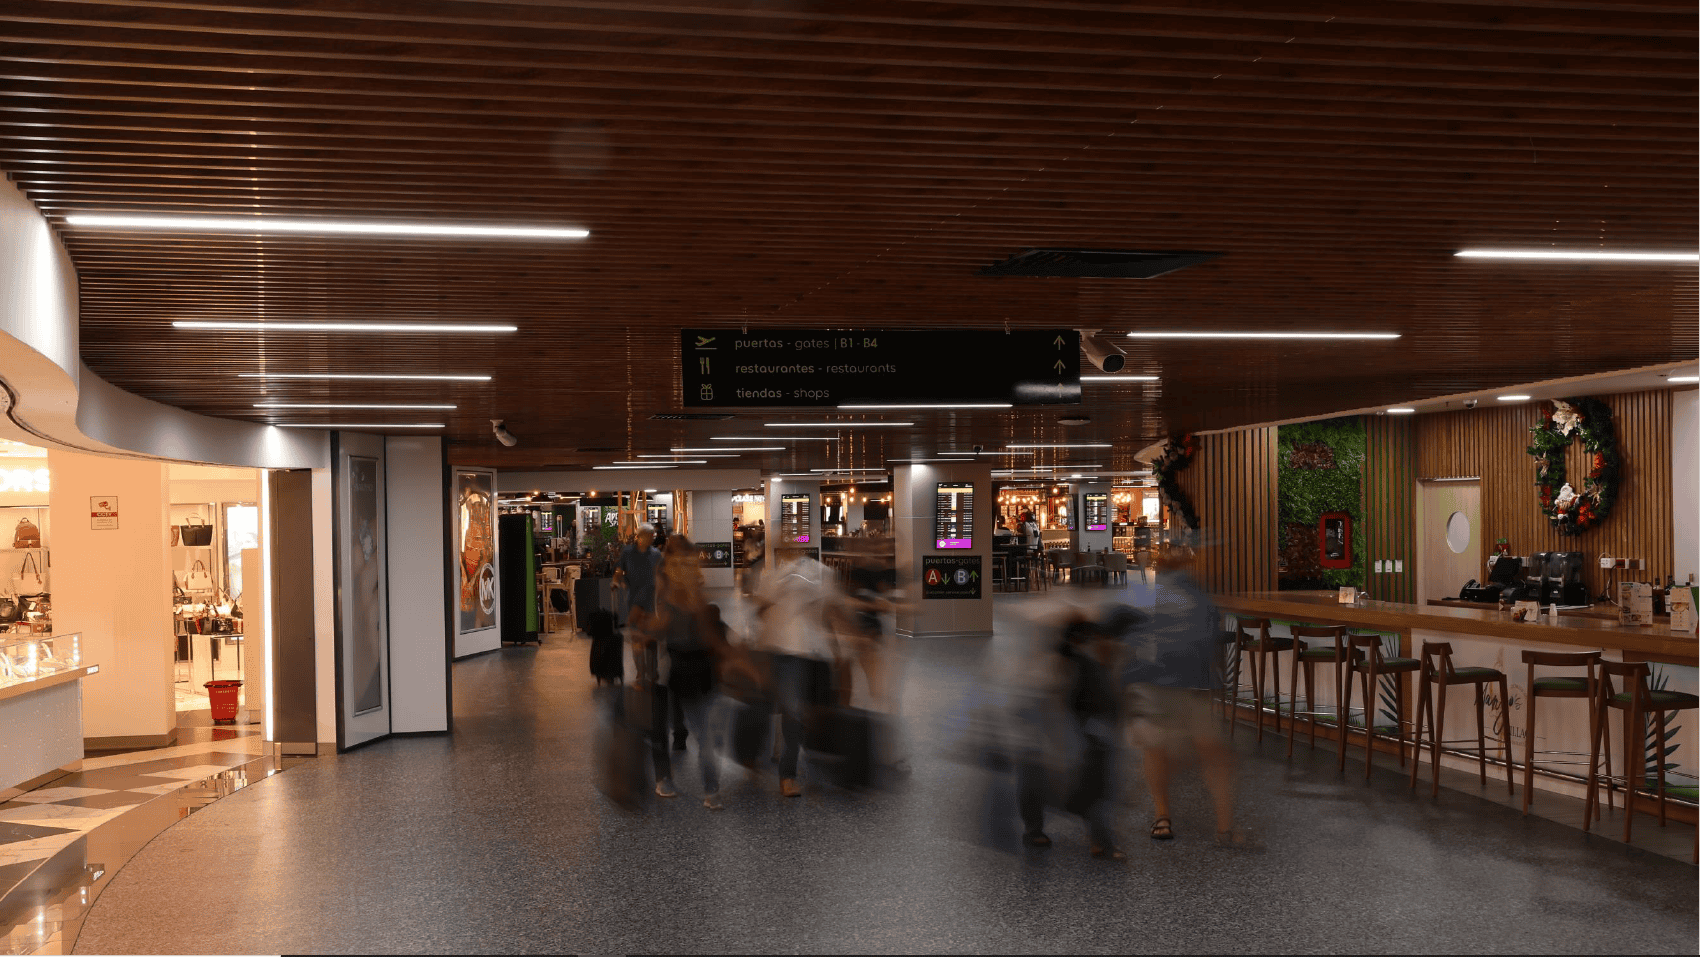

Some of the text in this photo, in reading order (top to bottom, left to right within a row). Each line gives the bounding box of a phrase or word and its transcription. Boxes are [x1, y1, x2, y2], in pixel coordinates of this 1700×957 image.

[735, 337, 783, 351] puertas
[795, 338, 830, 351] gates
[840, 337, 853, 349] B1
[863, 337, 878, 349] B4
[735, 363, 815, 374] restaurantes
[826, 363, 897, 374] restaurants
[736, 387, 782, 399] tiendas
[793, 388, 830, 400] shops
[715, 550, 723, 560] B
[928, 570, 966, 583] A B
